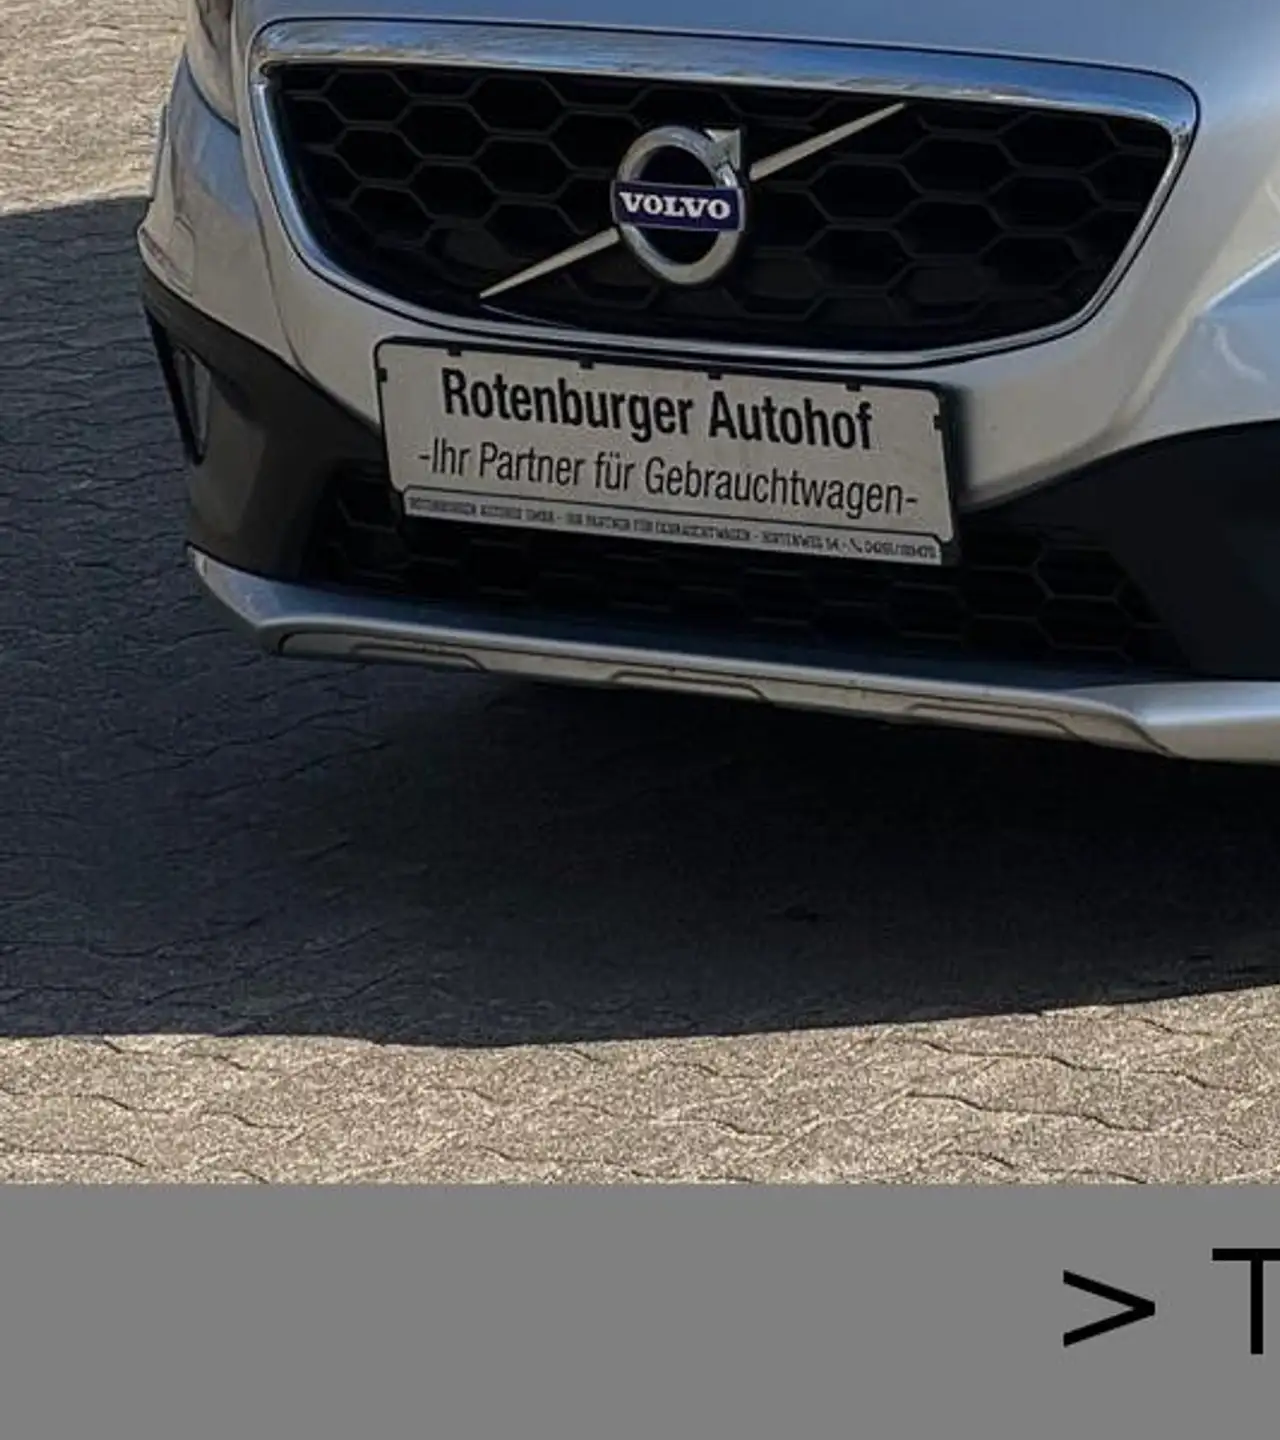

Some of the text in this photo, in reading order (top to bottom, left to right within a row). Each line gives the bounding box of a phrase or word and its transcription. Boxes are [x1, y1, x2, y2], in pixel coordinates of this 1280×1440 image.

[618, 191, 732, 221] VOLVO
[441, 367, 873, 450] Rotenburger Autohof
[418, 436, 919, 520] -Ihr Partner für Gebrauchtwagen-
